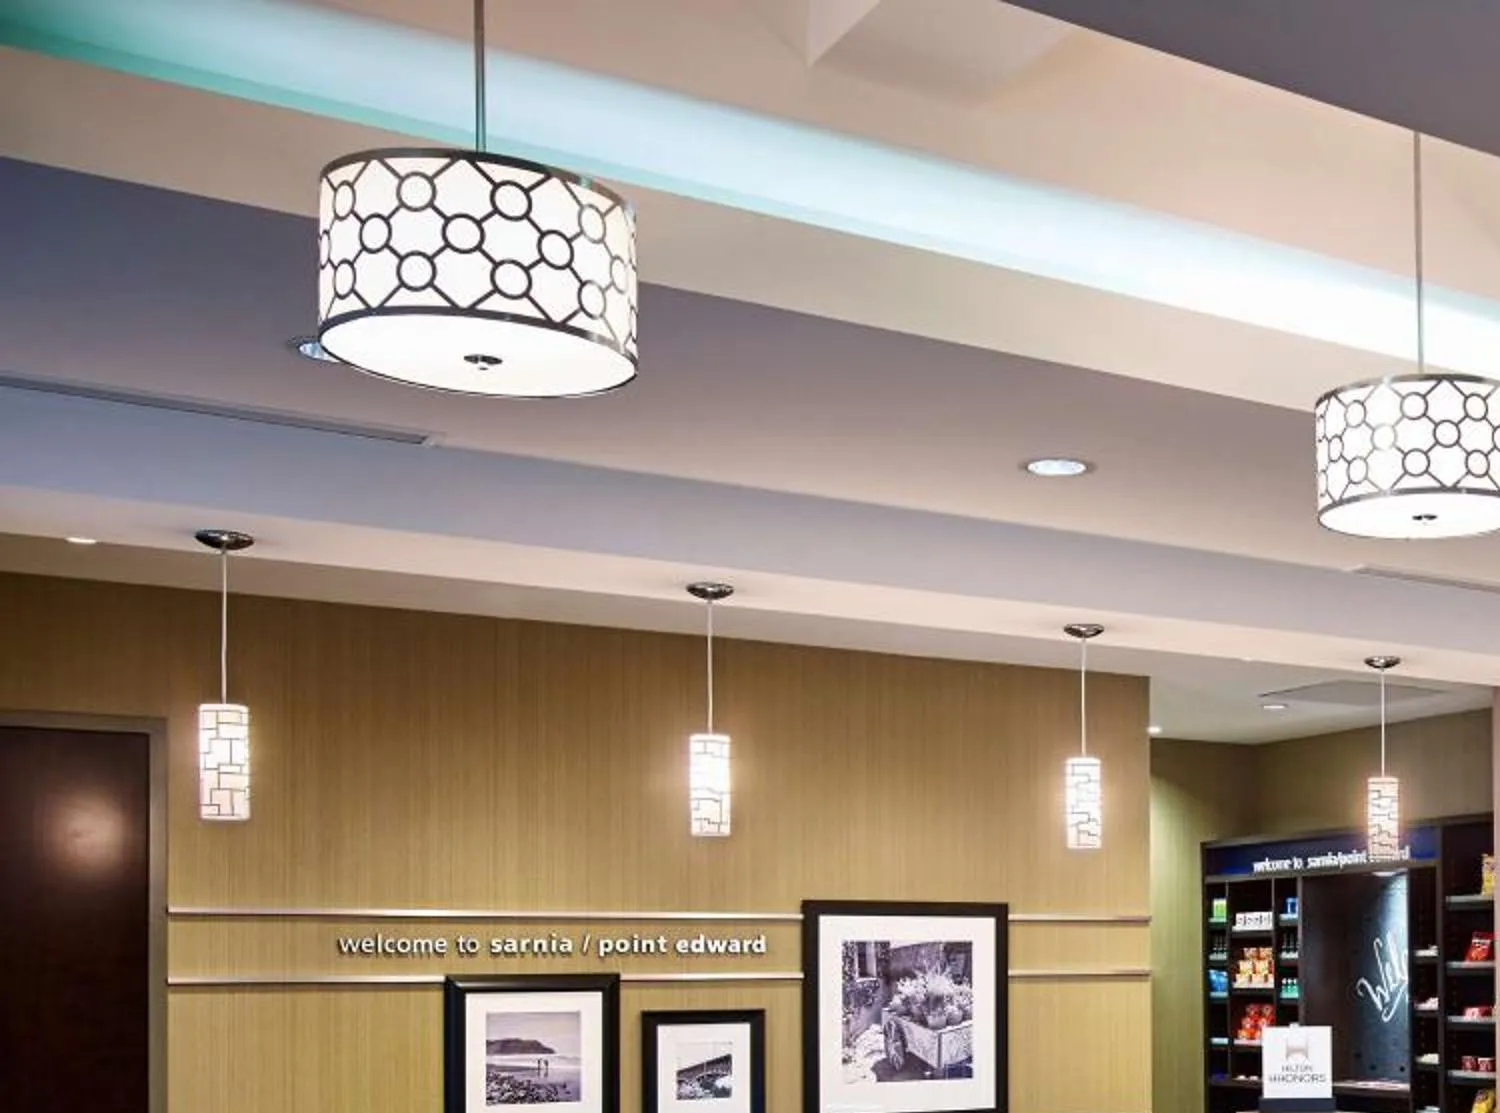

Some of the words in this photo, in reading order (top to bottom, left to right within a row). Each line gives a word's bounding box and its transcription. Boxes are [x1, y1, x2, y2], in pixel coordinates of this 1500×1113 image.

[339, 933, 448, 954] welcome
[457, 936, 480, 954] to
[490, 933, 573, 954] sarnia
[599, 934, 668, 957] point
[675, 934, 767, 954] edward
